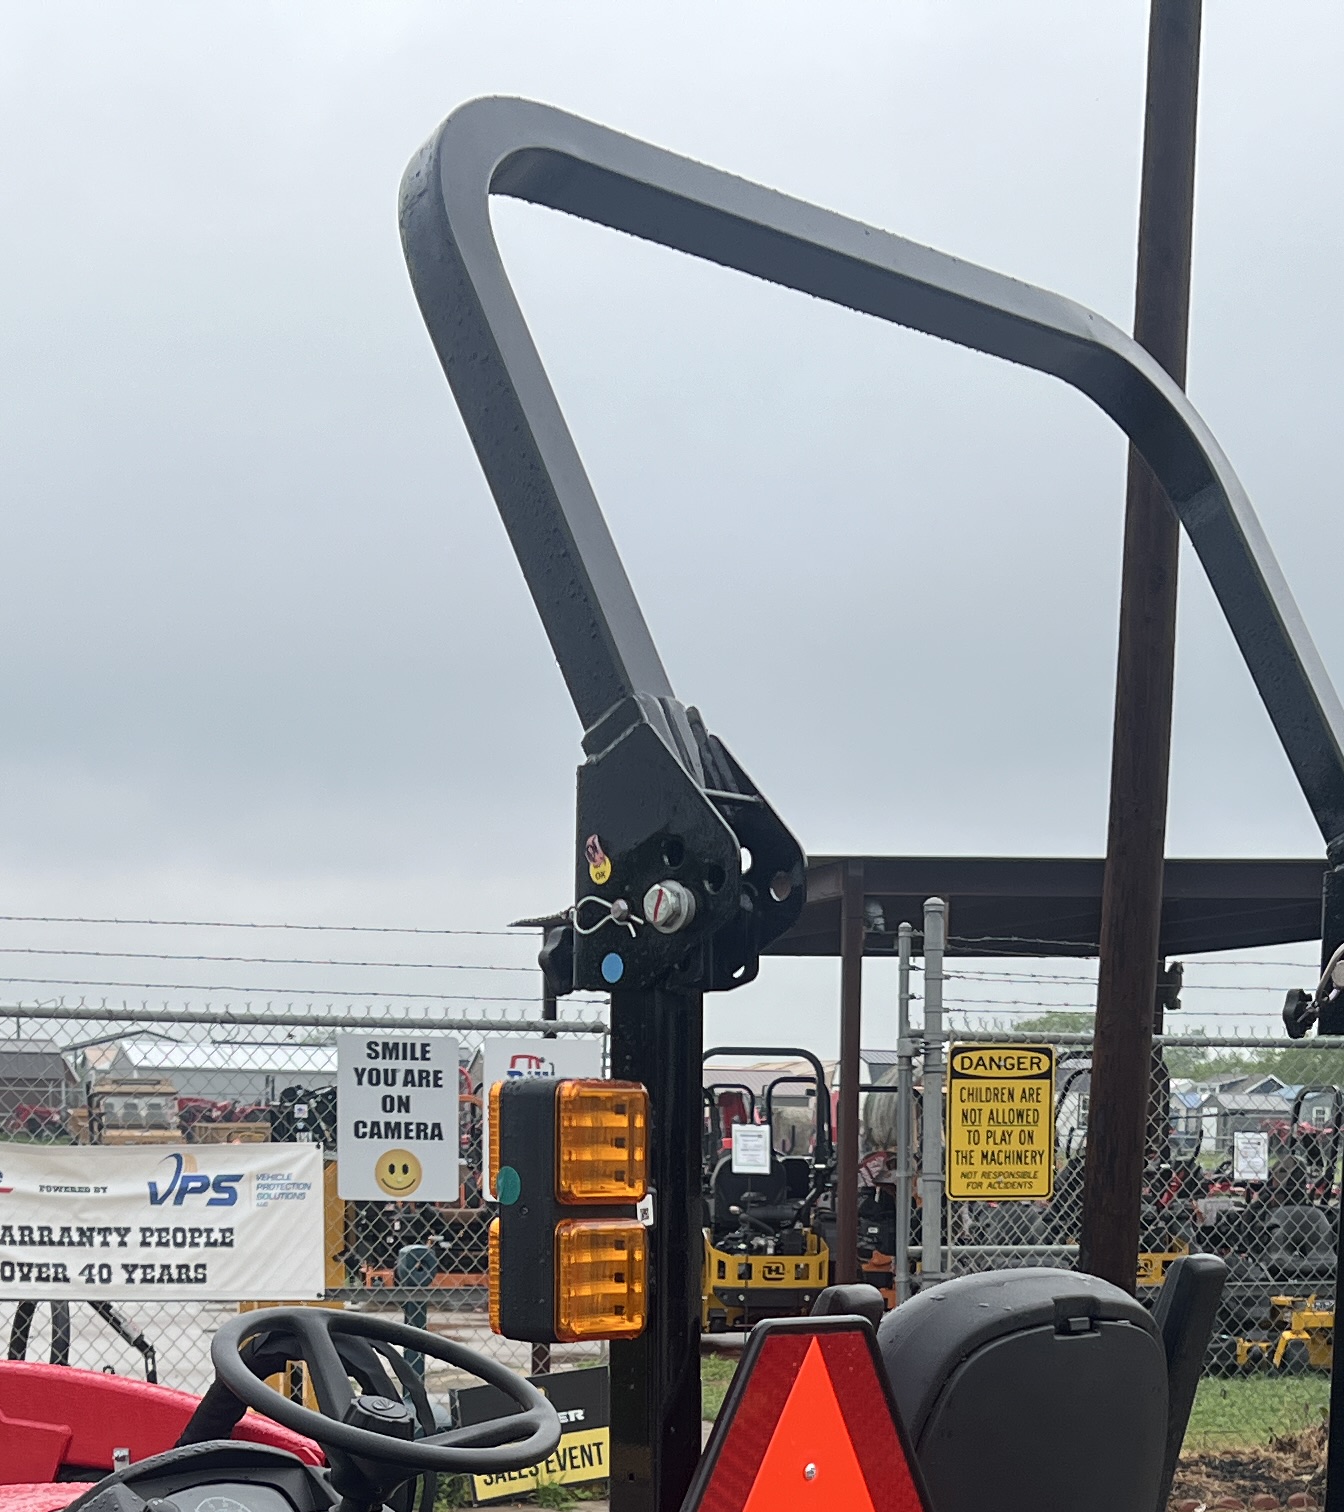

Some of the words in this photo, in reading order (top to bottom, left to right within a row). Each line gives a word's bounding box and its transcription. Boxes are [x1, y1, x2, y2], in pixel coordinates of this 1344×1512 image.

[365, 1040, 431, 1062] SMILE
[960, 1056, 1042, 1071] DANGER
[353, 1067, 399, 1087] YOU
[402, 1068, 443, 1089] ARE
[959, 1087, 1015, 1103] CHILDREN
[1019, 1087, 1042, 1103] ARE
[381, 1095, 411, 1114] ON
[961, 1108, 983, 1125] NOT
[987, 1108, 1040, 1125] ALLOWED
[353, 1120, 444, 1141] CAMERA
[967, 1129, 981, 1145] TO
[986, 1129, 1014, 1145] PLAY
[1018, 1129, 1034, 1145] ON
[955, 1150, 975, 1165] THE
[980, 1150, 1045, 1165] MACHINERY
[147, 1153, 244, 1206] VPS
[960, 1170, 978, 1180] NOT
[980, 1170, 1039, 1179] RESPONSIBLE
[38, 1184, 91, 1193] POWERED
[93, 1185, 109, 1193] BY
[966, 1181, 983, 1190] FOR
[986, 1181, 1034, 1190] ACCIDENTS
[138, 1226, 235, 1248] PEOPLE
[0, 1261, 71, 1284] OVER
[78, 1263, 113, 1284] 40
[120, 1263, 209, 1285] YEARS
[545, 1441, 604, 1474] EVENT
